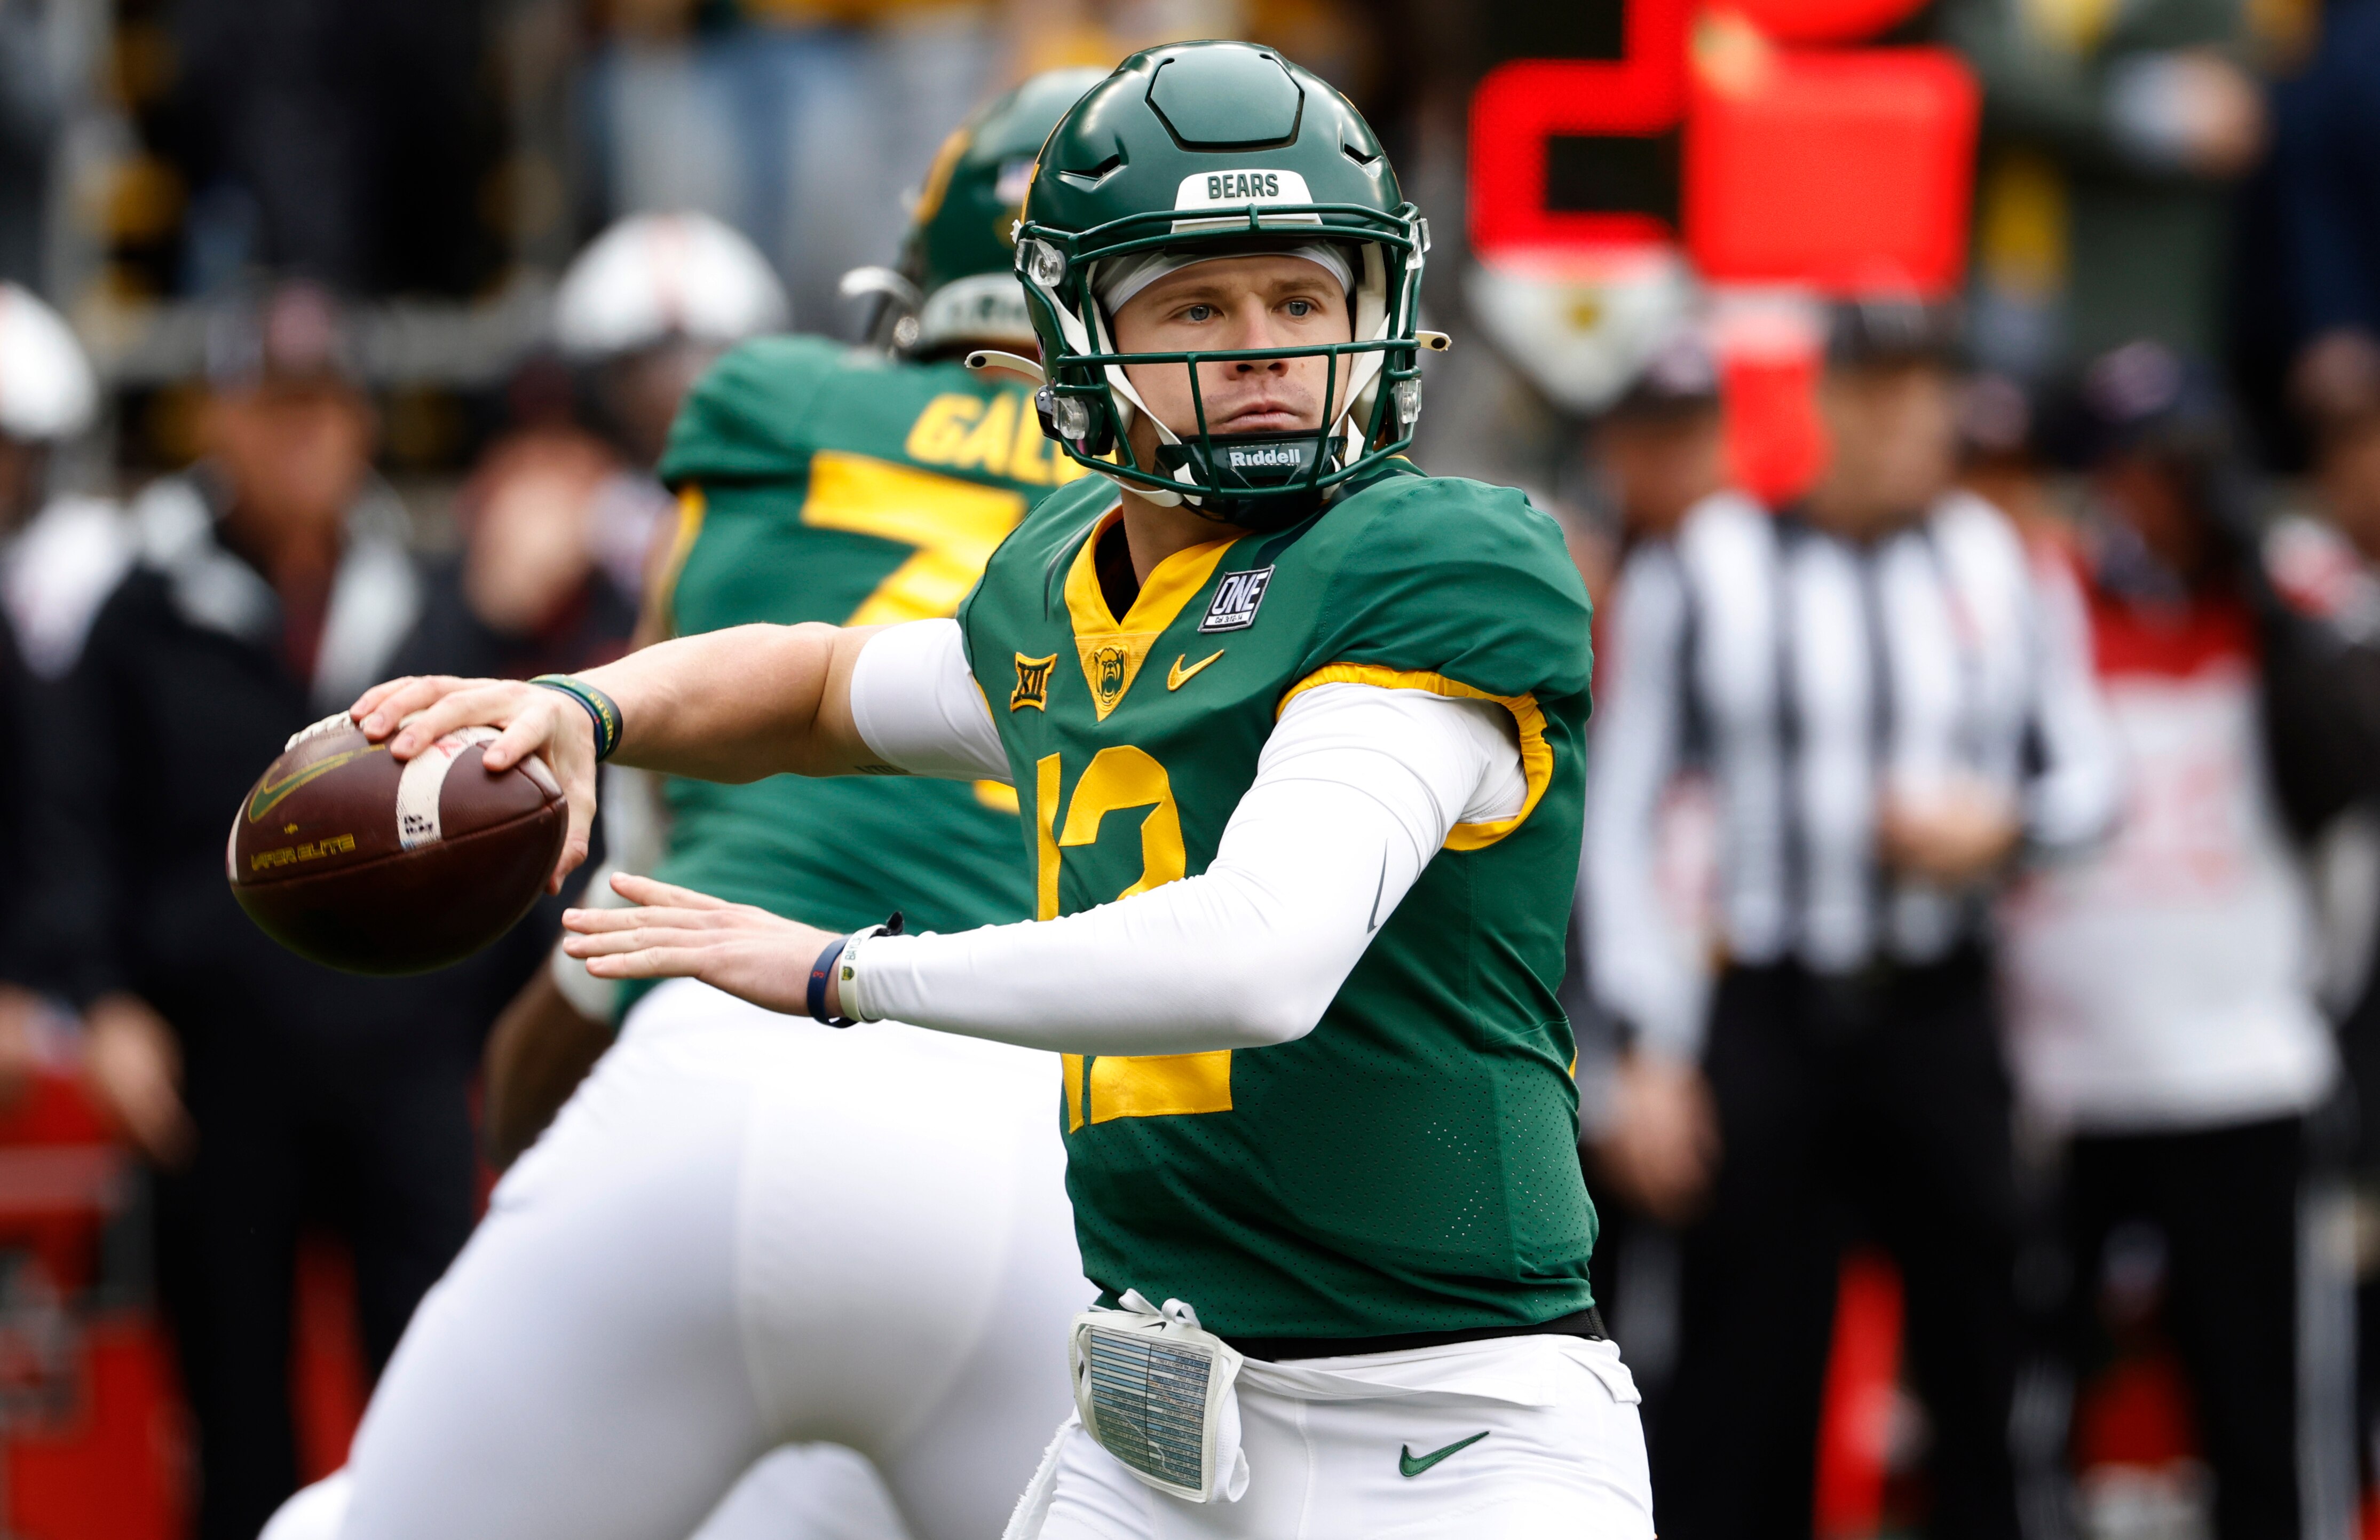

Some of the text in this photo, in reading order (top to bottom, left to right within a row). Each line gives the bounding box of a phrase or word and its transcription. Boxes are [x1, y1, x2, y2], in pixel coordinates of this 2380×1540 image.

[1207, 173, 1279, 199] BEARS
[1229, 449, 1300, 466] Riddell
[1212, 571, 1269, 615] ONE
[1037, 745, 1232, 1134] 12
